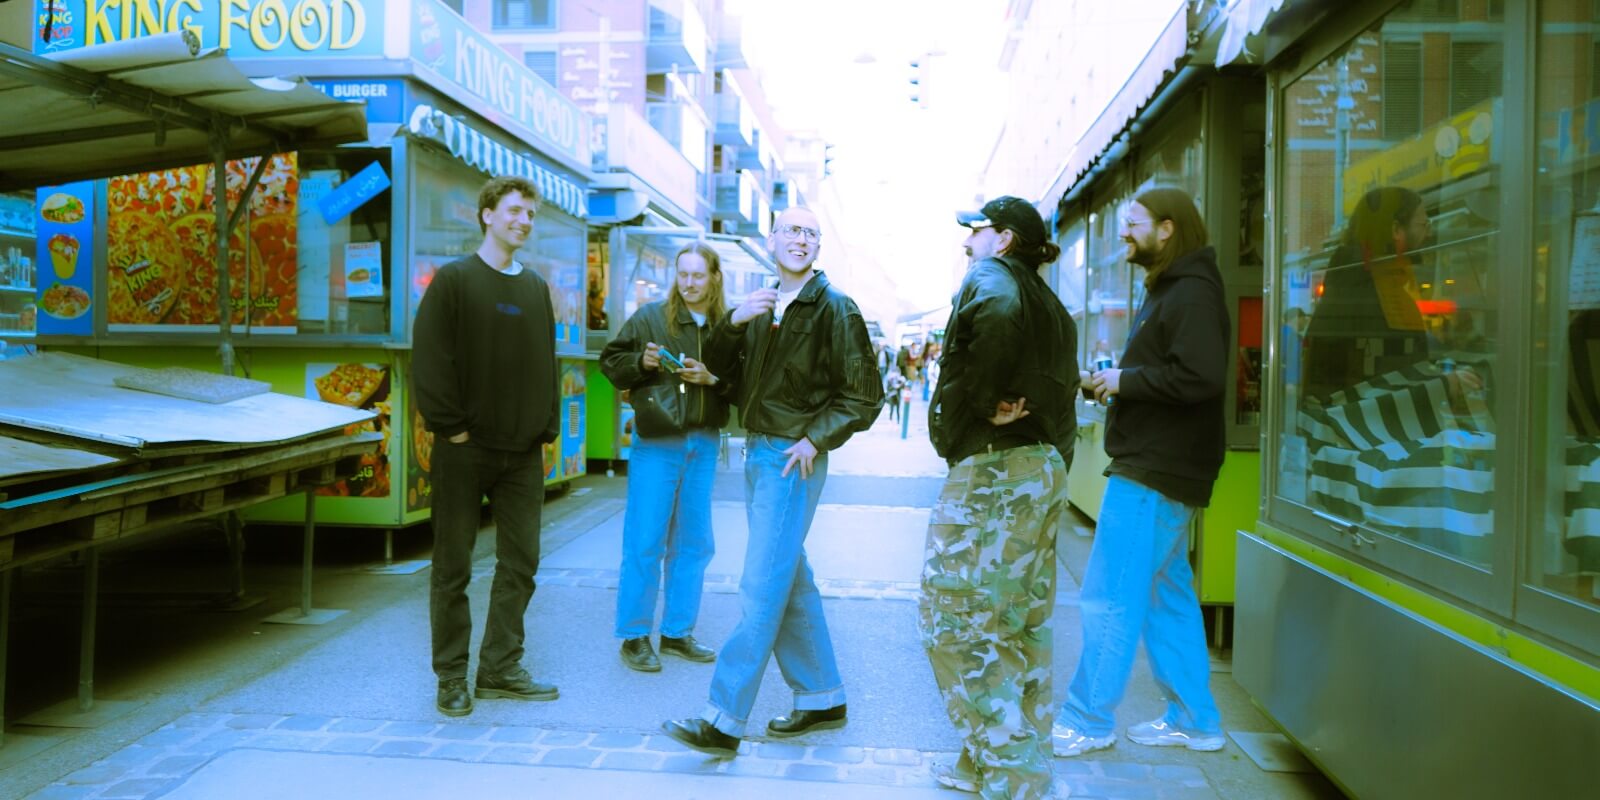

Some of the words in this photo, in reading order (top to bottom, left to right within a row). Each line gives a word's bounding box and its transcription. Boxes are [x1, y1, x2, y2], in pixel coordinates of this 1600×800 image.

[84, 0, 203, 48] KING
[218, 0, 366, 51] FOOD
[333, 83, 388, 97] BURGER
[456, 28, 515, 116] KING
[520, 75, 574, 149] FOOD
[127, 265, 161, 293] KING
